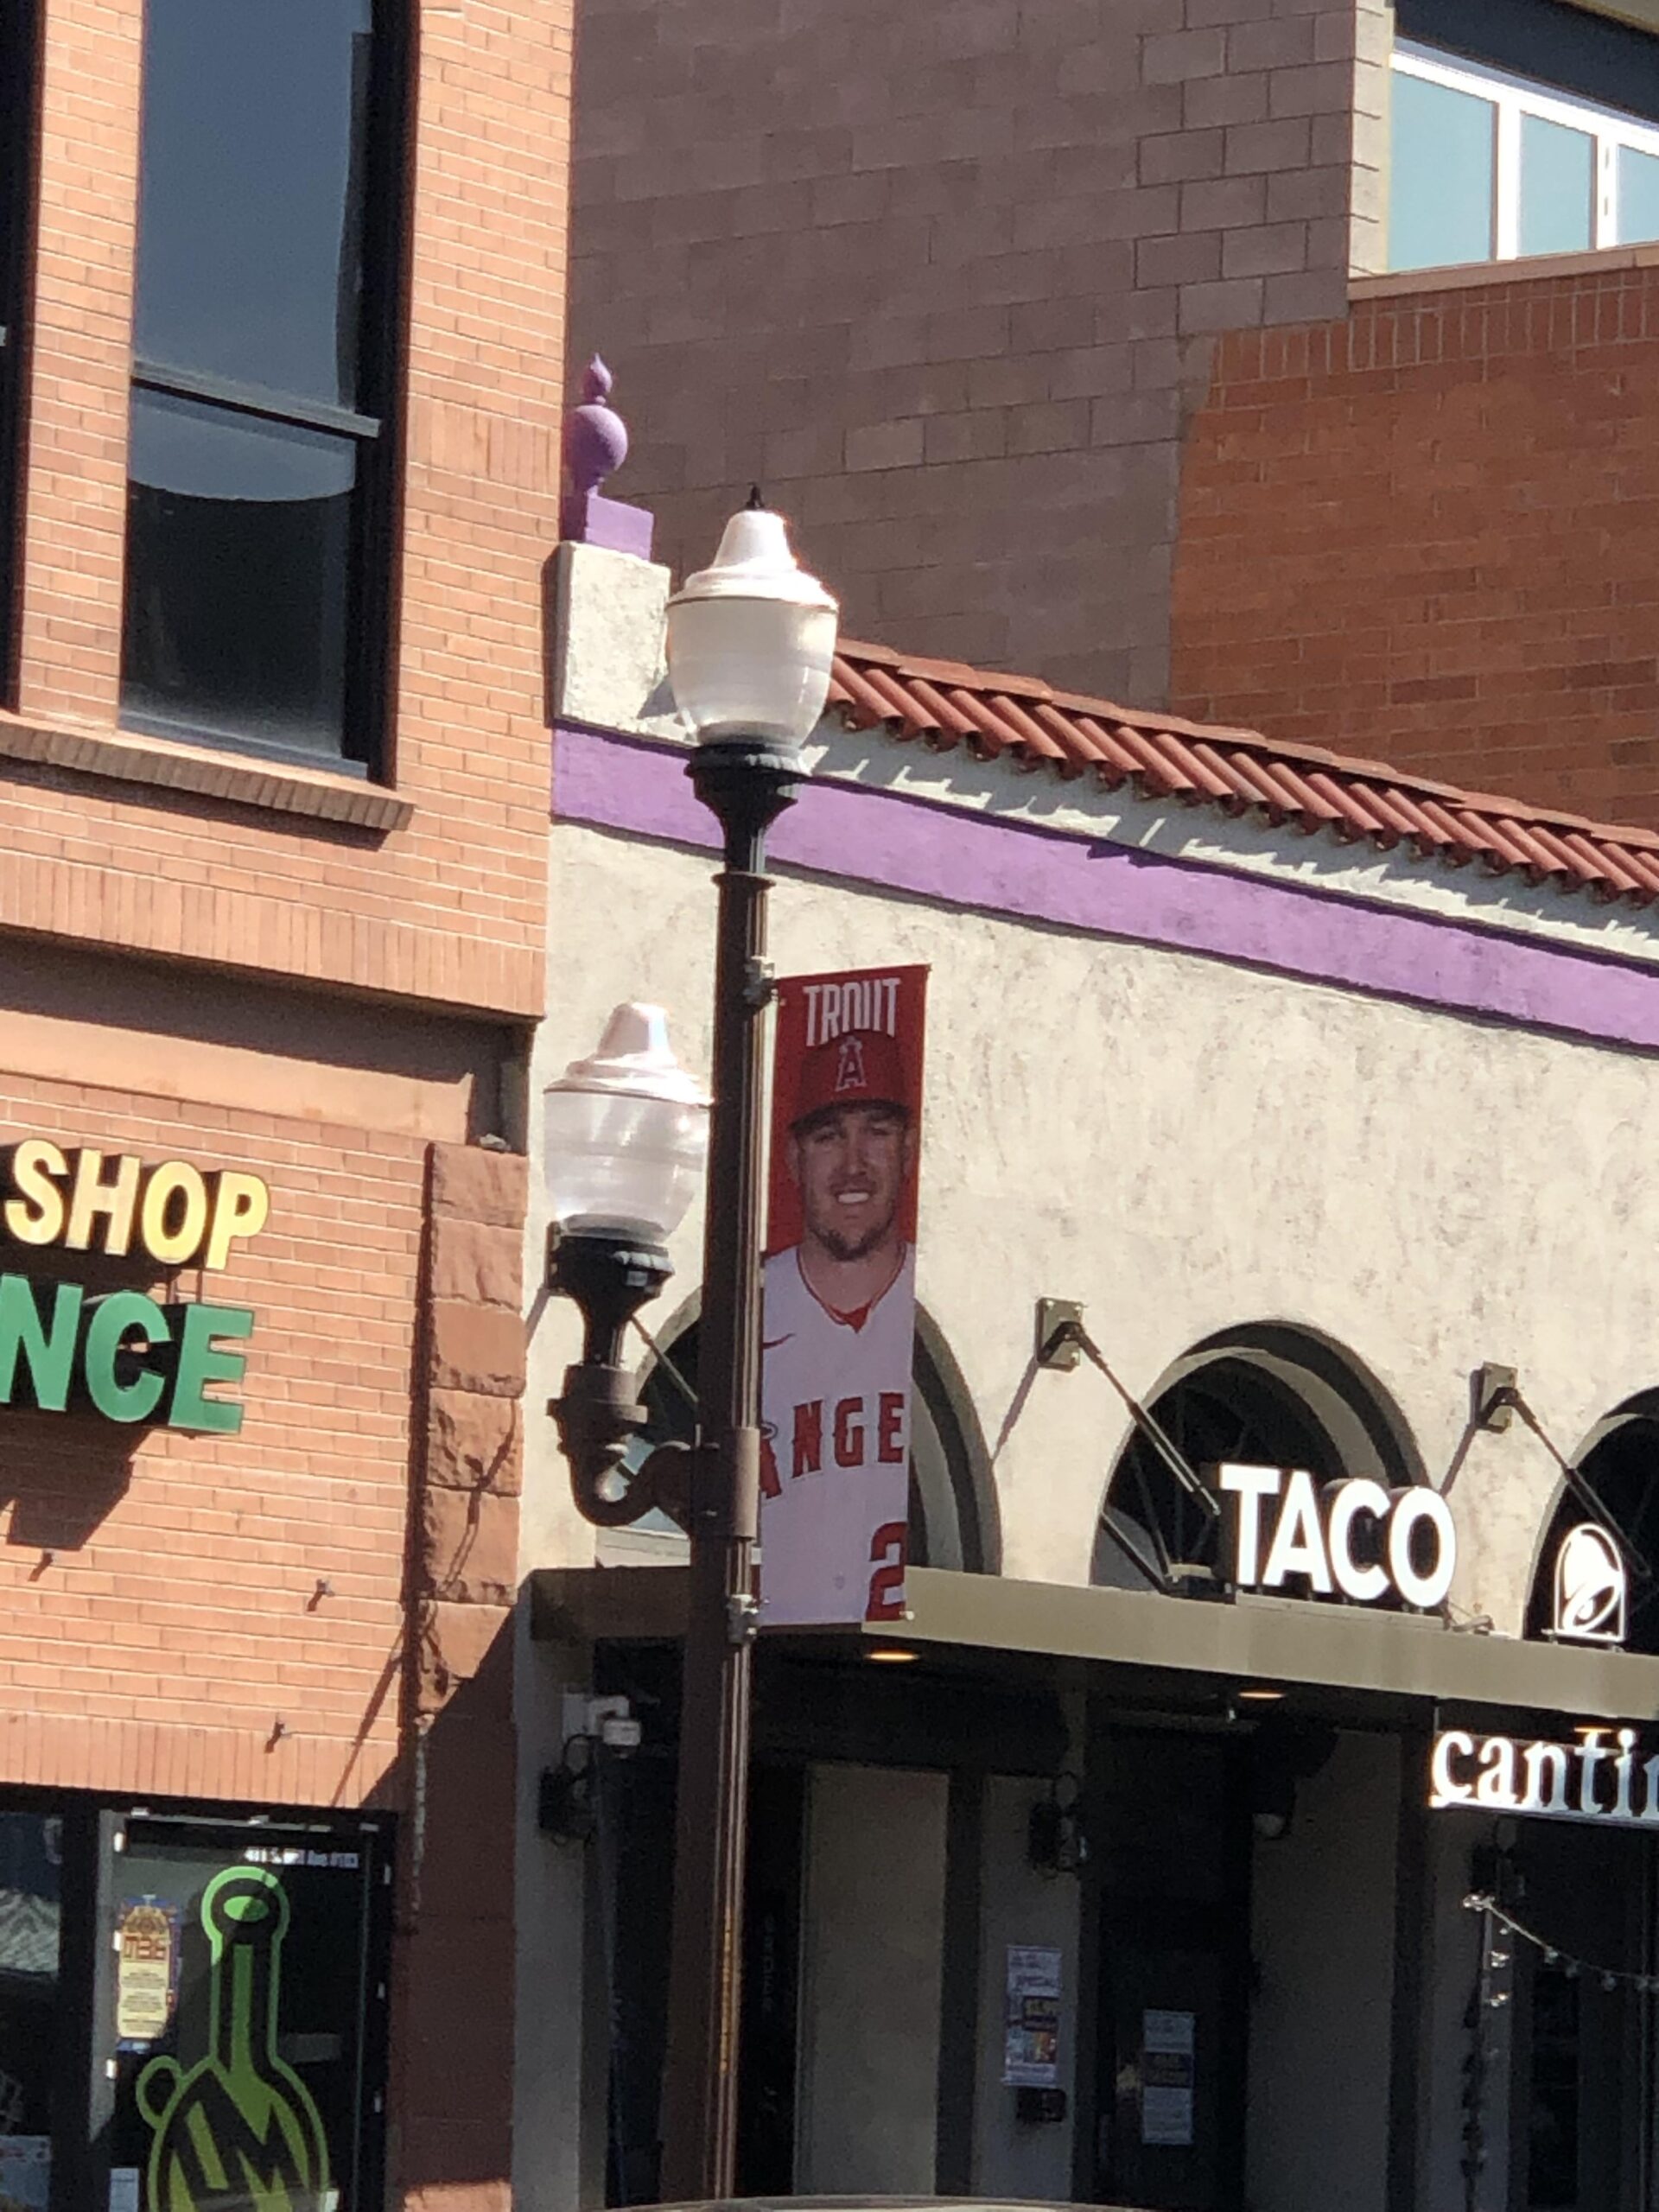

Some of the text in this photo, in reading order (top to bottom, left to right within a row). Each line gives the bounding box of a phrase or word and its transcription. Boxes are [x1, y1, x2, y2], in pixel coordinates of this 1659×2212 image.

[803, 977, 901, 1046] TROUT
[834, 1035, 867, 1092] A
[4, 1139, 270, 1270] SHOP
[0, 1272, 254, 1434] NCE
[867, 1522, 907, 1622] 2
[1220, 1464, 1457, 1607] TACO
